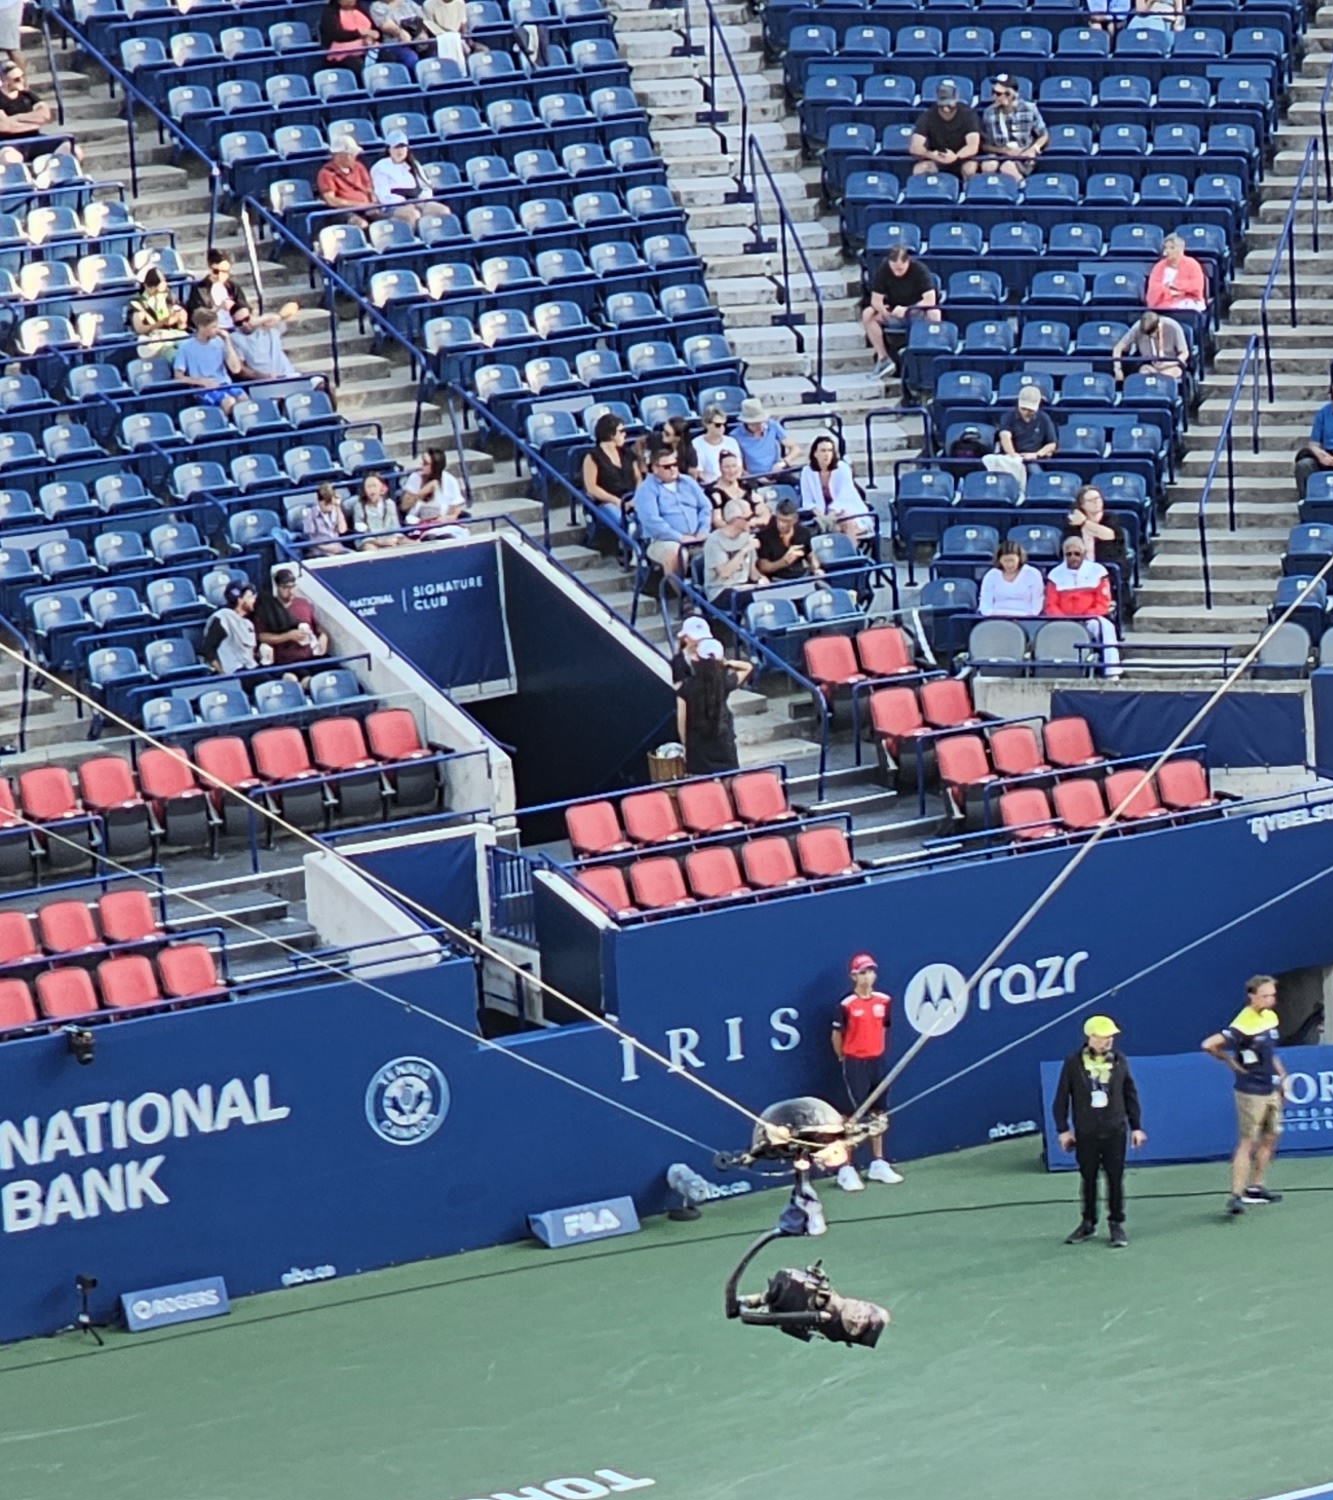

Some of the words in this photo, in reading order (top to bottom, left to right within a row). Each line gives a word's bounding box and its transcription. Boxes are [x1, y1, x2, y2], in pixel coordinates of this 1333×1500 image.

[412, 575, 484, 598] SIGNATURE
[413, 596, 449, 611] CLUB
[978, 951, 1089, 1011] razr
[618, 1007, 801, 1082] IRIS
[0, 1073, 291, 1170] NATIONAL
[1, 1154, 170, 1233] BANK
